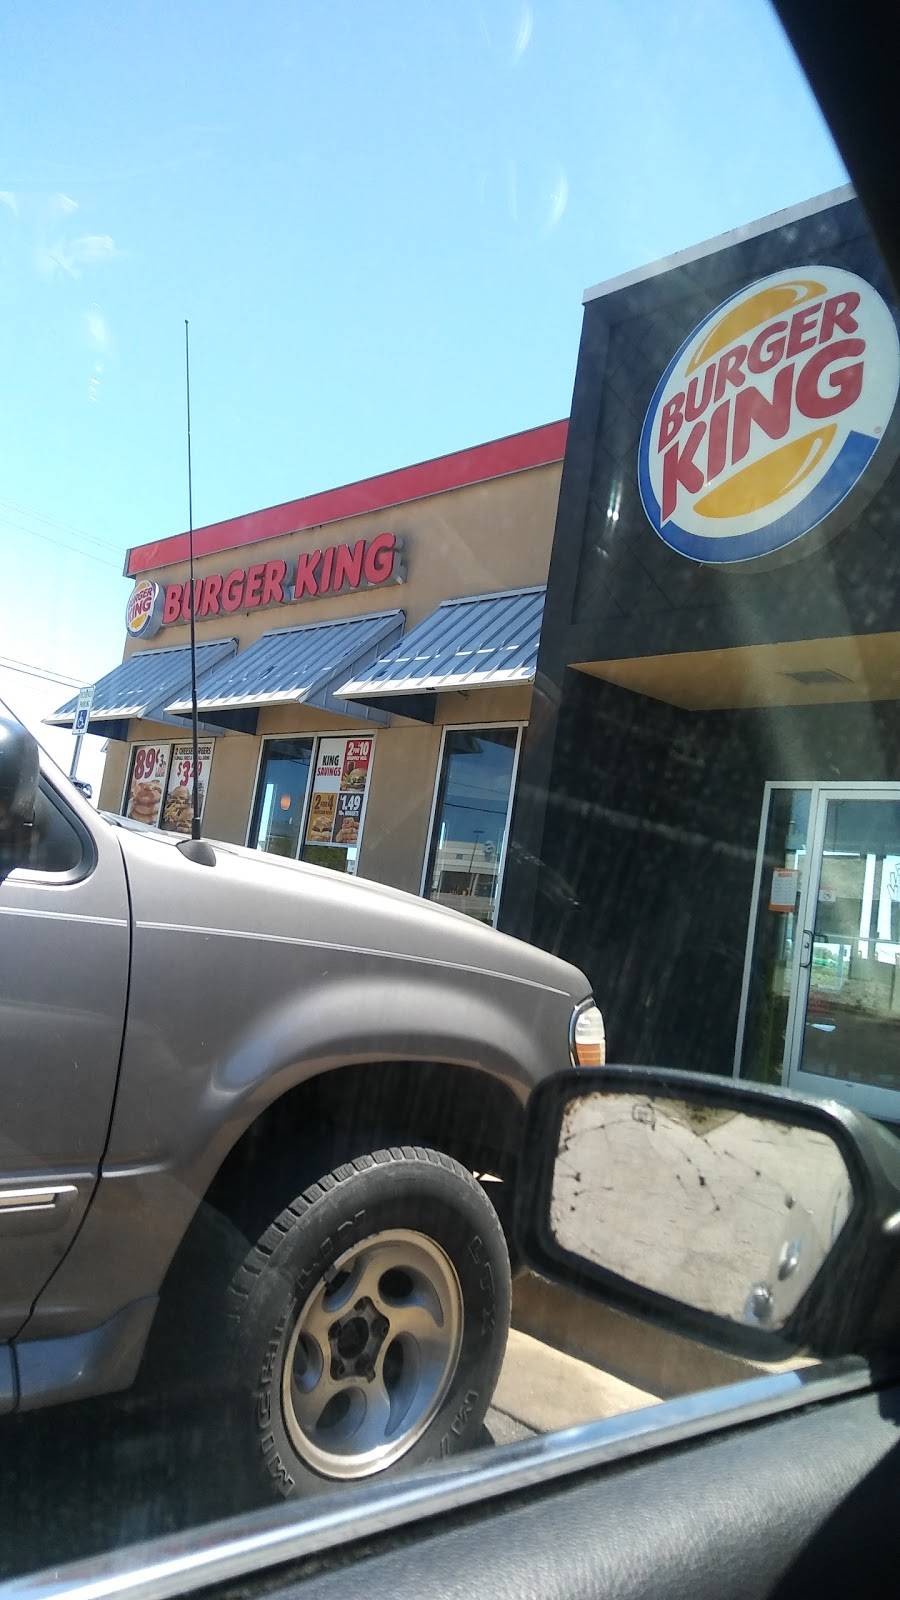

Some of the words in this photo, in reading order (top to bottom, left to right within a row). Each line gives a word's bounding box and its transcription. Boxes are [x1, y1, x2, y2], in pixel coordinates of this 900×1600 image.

[658, 291, 861, 455] BURGER
[661, 338, 866, 523] KING
[162, 559, 287, 625] BURGER
[294, 532, 397, 599] KING
[316, 767, 342, 777] SAVINGS
[322, 754, 340, 767] KING
[347, 741, 354, 756] 2
[314, 795, 322, 809] 2
[257, 1208, 366, 1499] MICHLIN
